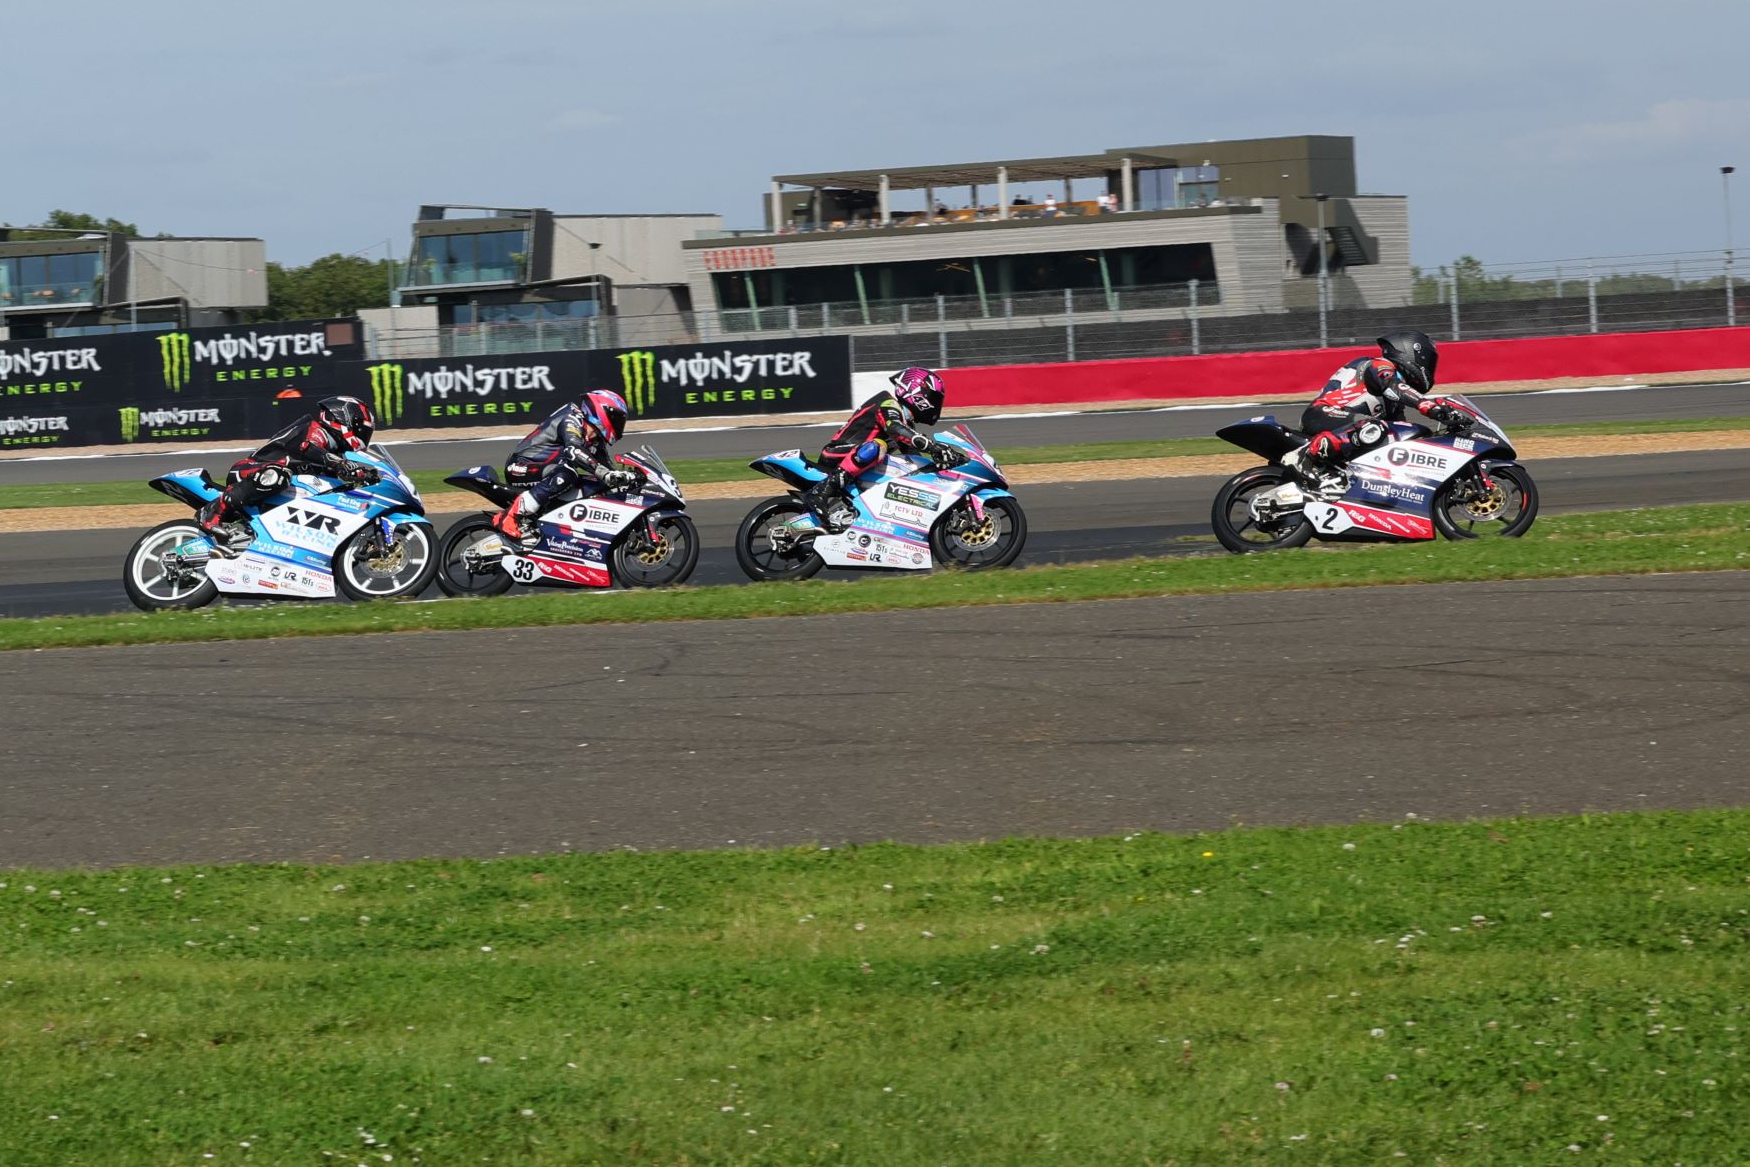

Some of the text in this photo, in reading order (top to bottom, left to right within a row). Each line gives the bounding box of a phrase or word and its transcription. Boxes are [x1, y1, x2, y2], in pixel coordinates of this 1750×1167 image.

[216, 365, 312, 382] ENERGY
[659, 350, 817, 386] MONSTER
[407, 364, 555, 399] MONSTER
[685, 388, 794, 404] ENERGY
[140, 407, 220, 427] MONSTER
[430, 401, 533, 417] ENERGY
[1387, 447, 1447, 469] FIBRE
[890, 483, 939, 502] YESSS
[570, 504, 620, 523] FIBRE
[1322, 508, 1338, 530] 2
[513, 559, 534, 580] 33
